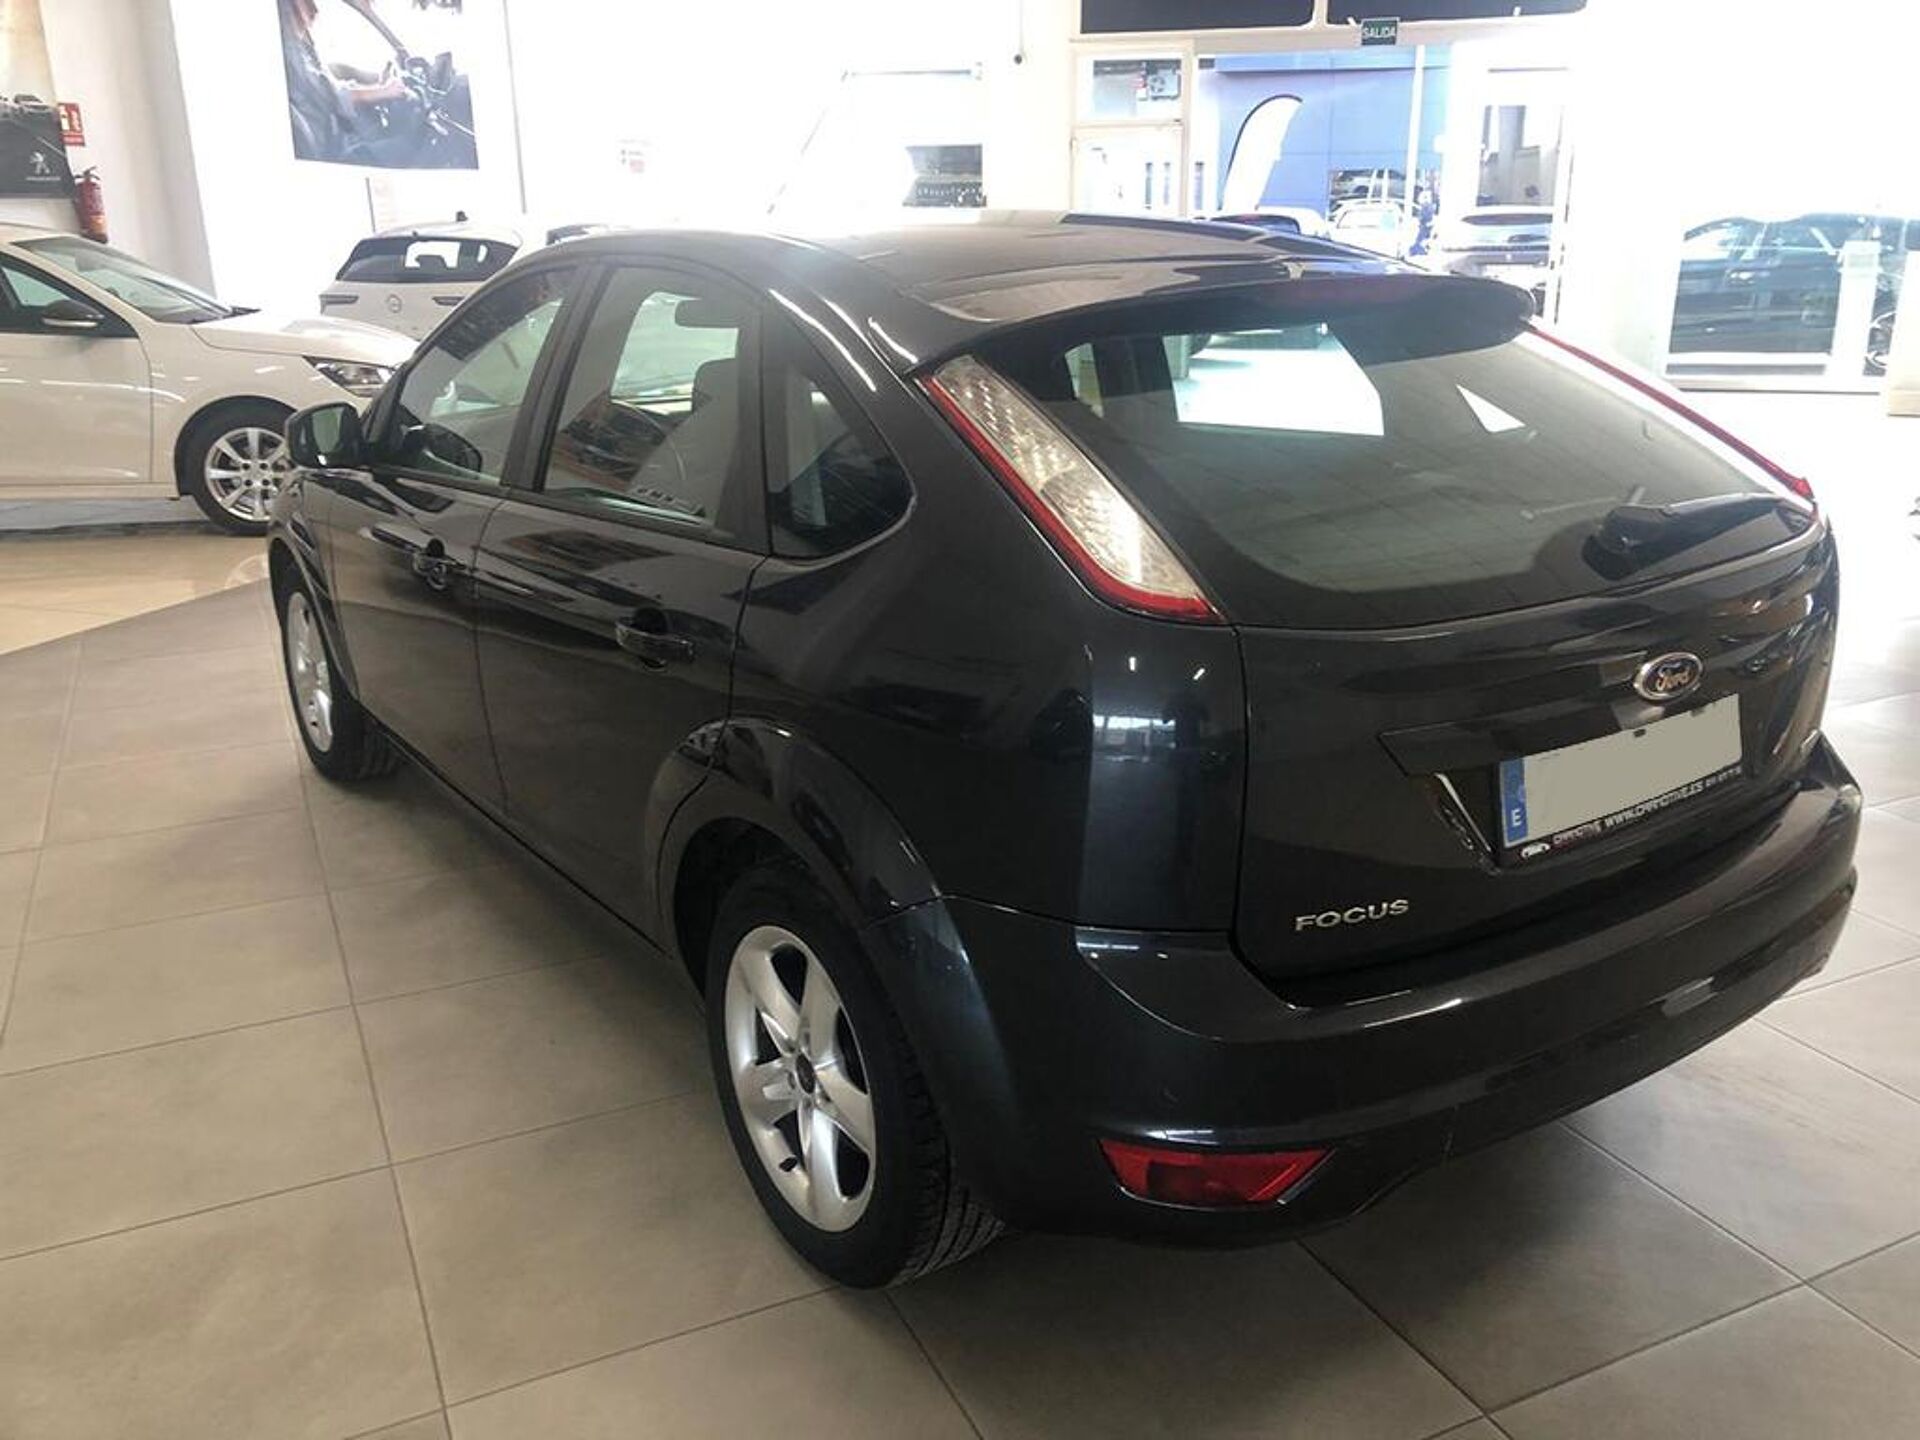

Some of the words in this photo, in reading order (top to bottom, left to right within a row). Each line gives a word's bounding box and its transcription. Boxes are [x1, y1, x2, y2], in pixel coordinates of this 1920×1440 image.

[1362, 26, 1396, 38] SALIDA
[1511, 807, 1522, 828] E
[1295, 899, 1409, 931] FOCUS
